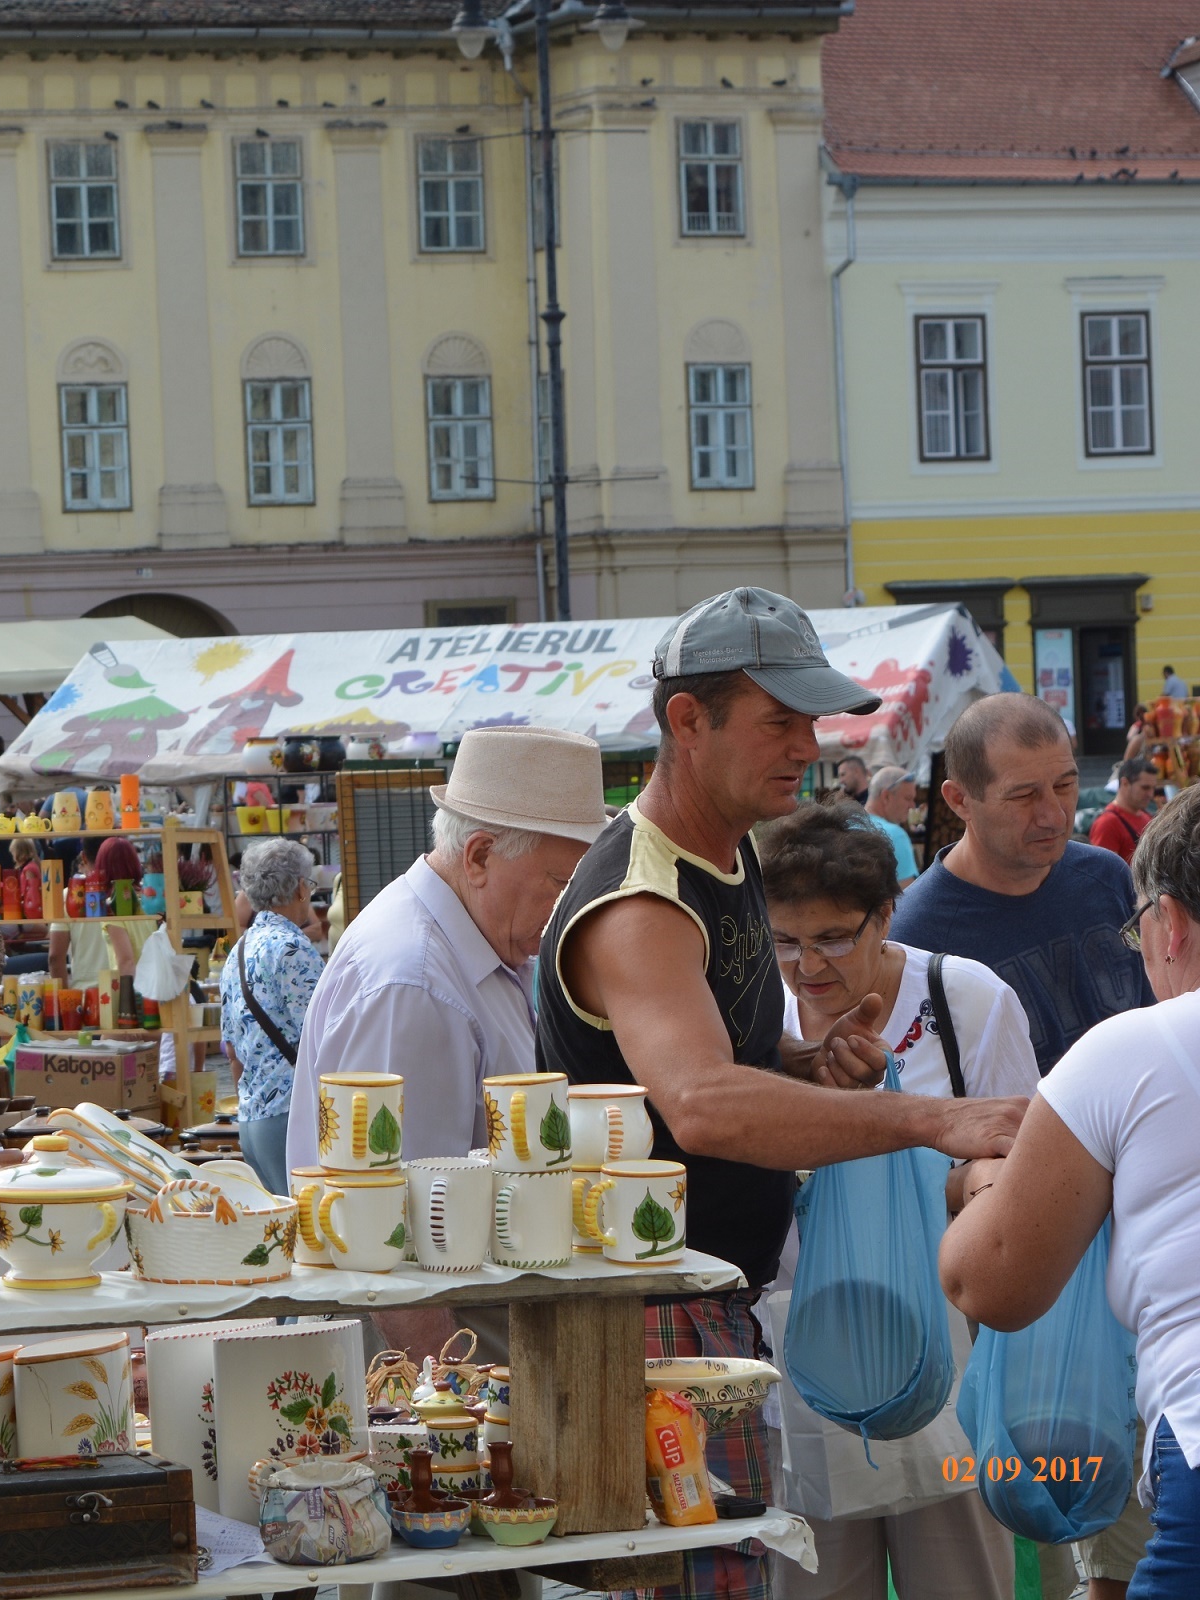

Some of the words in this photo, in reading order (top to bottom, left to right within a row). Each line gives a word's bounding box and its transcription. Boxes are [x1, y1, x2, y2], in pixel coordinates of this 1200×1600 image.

[385, 627, 618, 664] ATELIERUL
[693, 647, 743, 657] Mercedes-Benz
[699, 655, 736, 664] Motorsport
[44, 1053, 116, 1080] Katope
